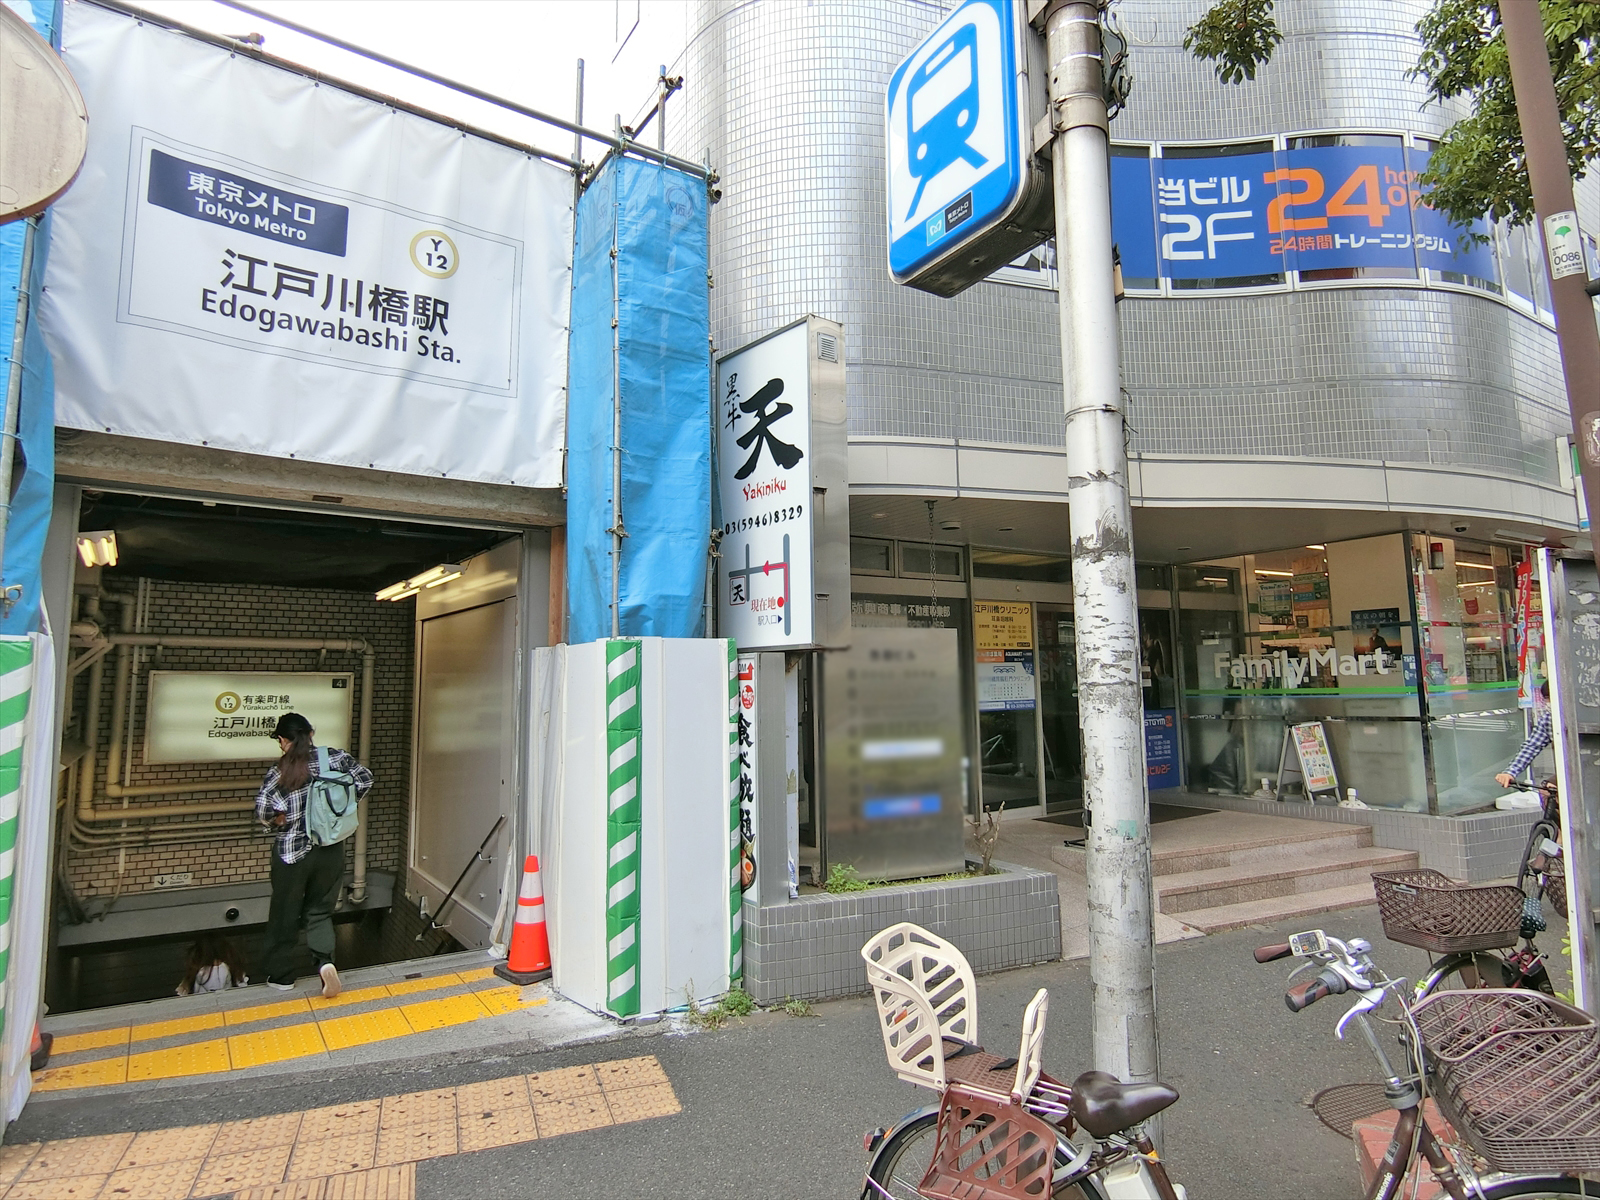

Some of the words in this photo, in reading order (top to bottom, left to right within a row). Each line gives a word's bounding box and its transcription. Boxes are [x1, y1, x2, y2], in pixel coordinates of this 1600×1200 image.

[187, 171, 316, 225] 東京メトロ
[1158, 175, 1250, 206] 当ビル
[1263, 164, 1391, 234] 24
[195, 196, 250, 225] Tokyo
[254, 214, 307, 241] Metro
[430, 238, 443, 252] Y
[1159, 210, 1255, 260] 2F
[426, 252, 448, 270] 12
[1554, 251, 1581, 266] 0086
[220, 248, 449, 336] 江戸川橋駅
[201, 288, 408, 352] Edogawabashi
[417, 335, 461, 364] Sta.
[723, 372, 742, 433] 黒牛
[734, 377, 804, 480] 天
[742, 477, 787, 502] Yakiniku
[725, 504, 803, 536] 03(5946)8329
[733, 584, 745, 602] 天
[750, 596, 776, 612] 現在地
[757, 614, 777, 626] 駅入口
[974, 604, 1030, 614] 江戸川橋クリニック
[1214, 646, 1389, 684] FamilyMart
[336, 679, 343, 687] 4
[243, 694, 290, 704] 有楽町線
[213, 716, 280, 729] 江戸川橋
